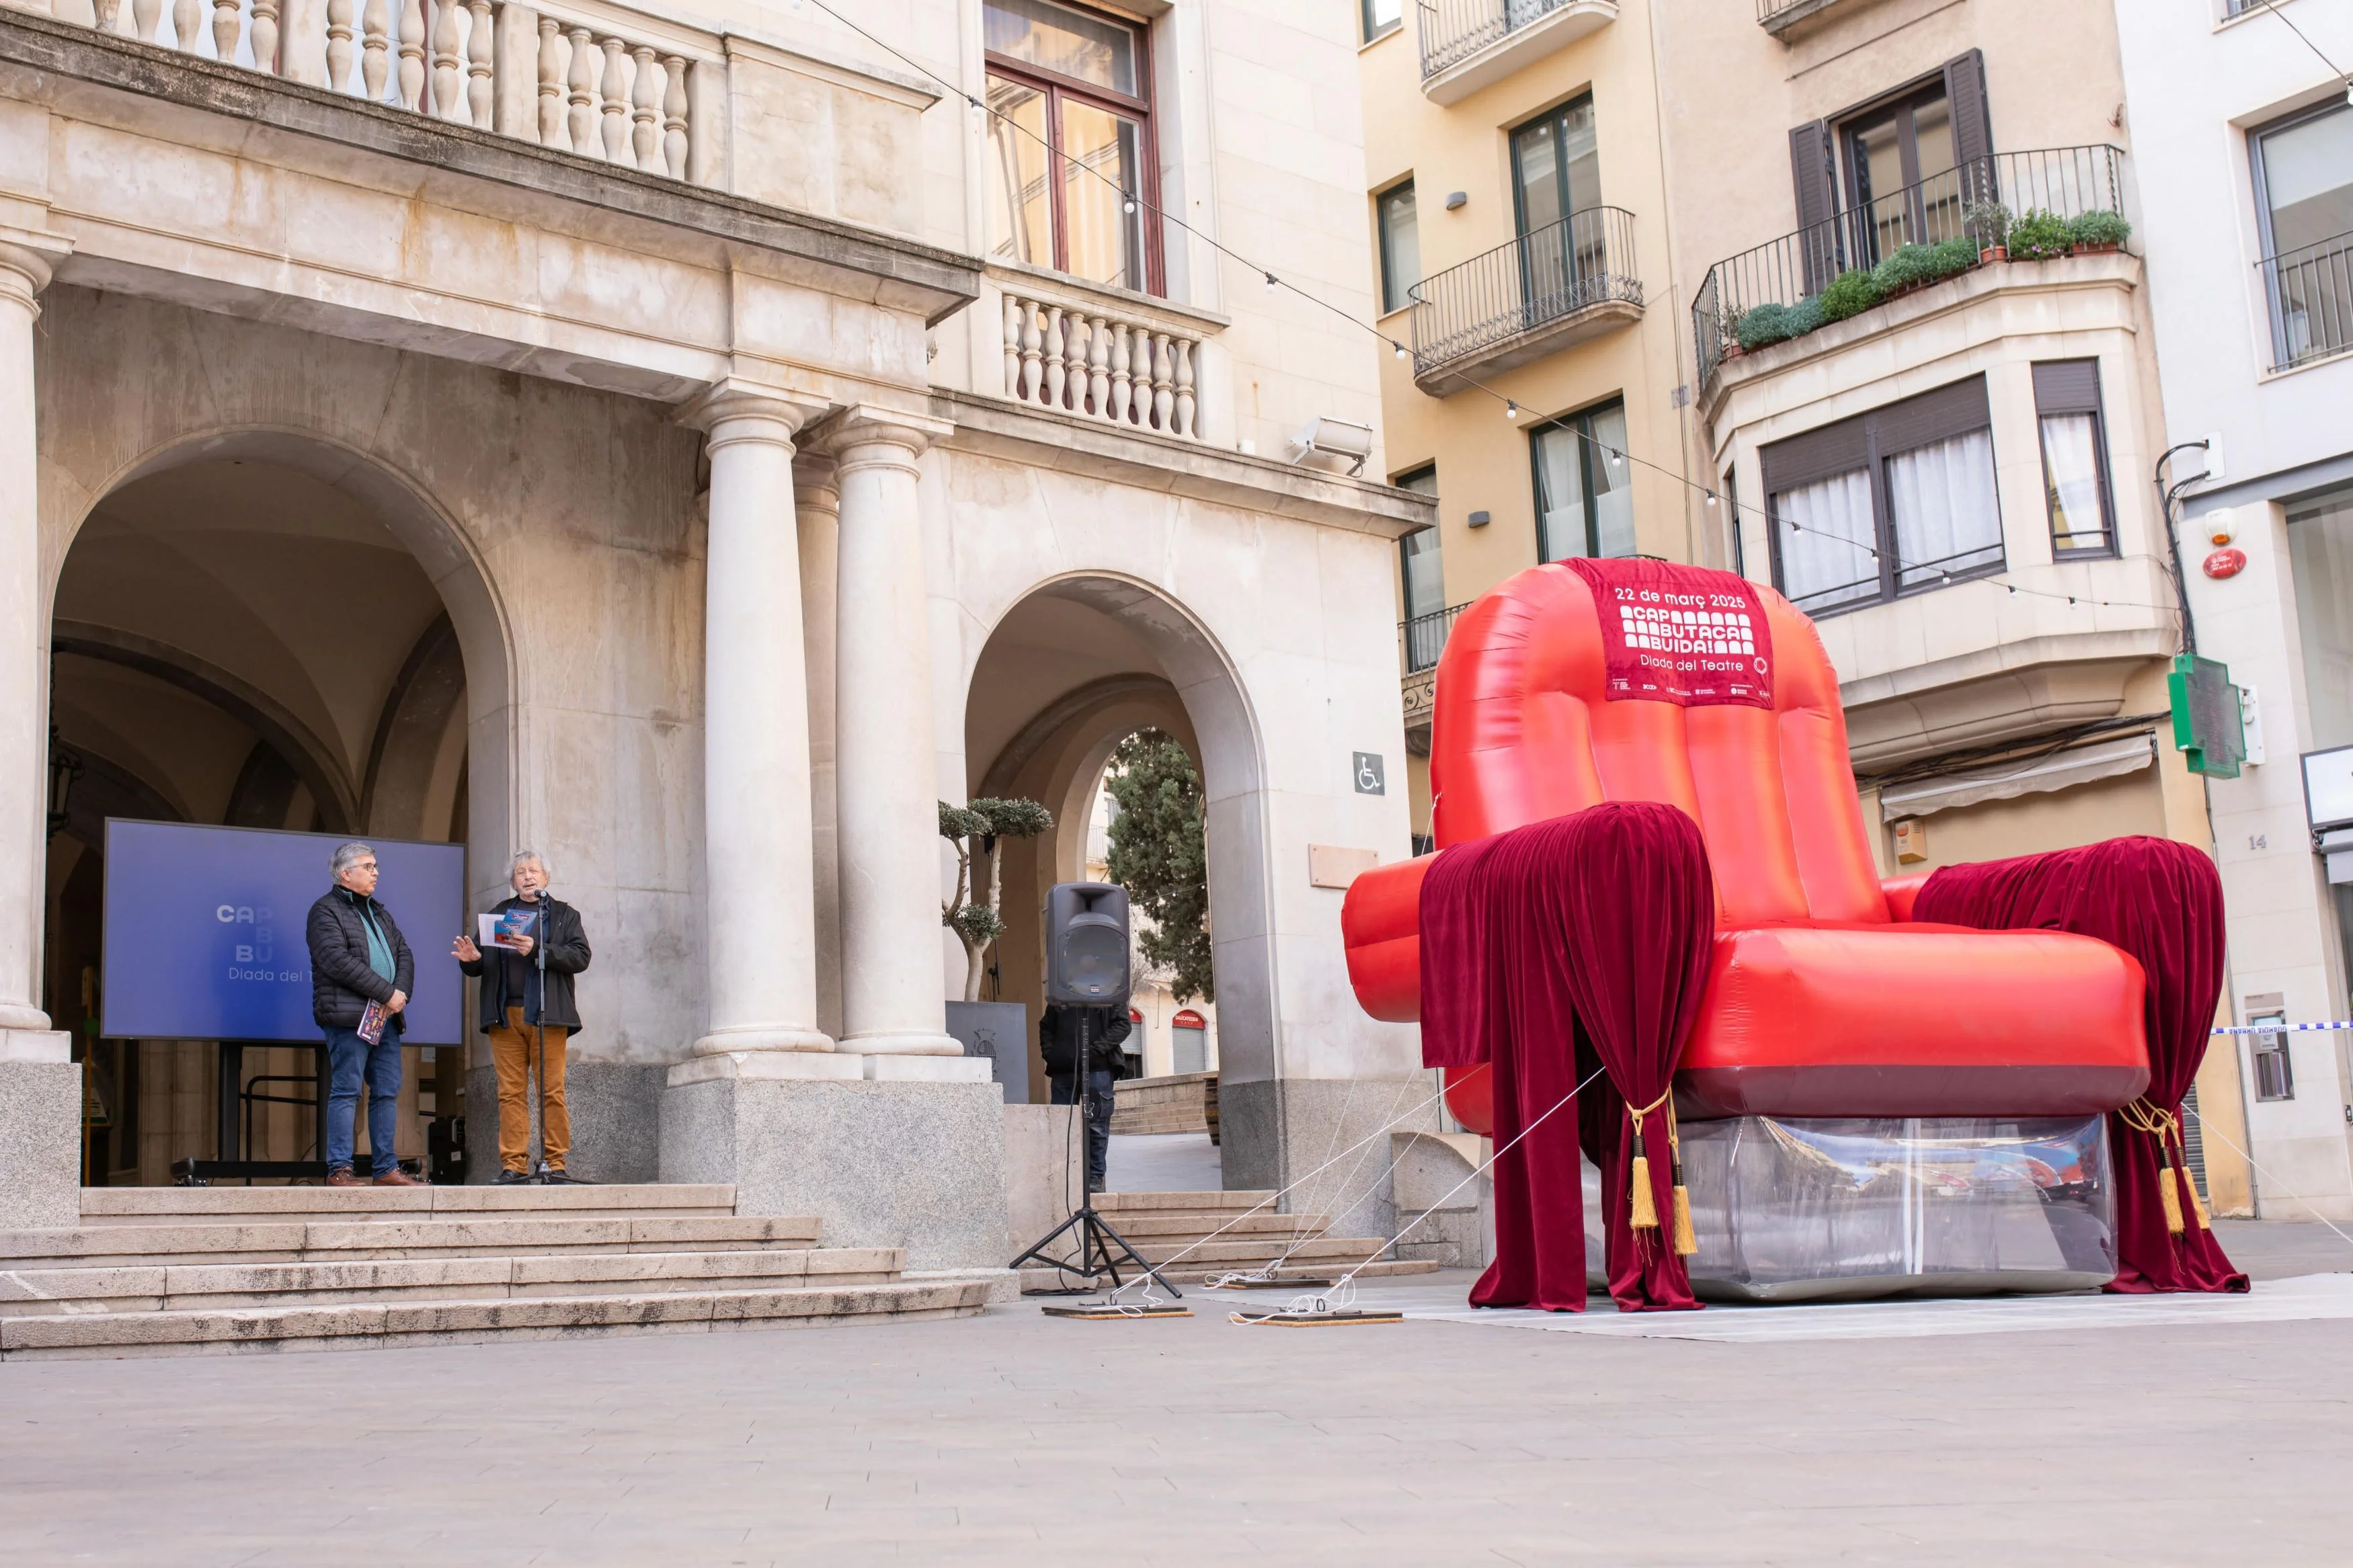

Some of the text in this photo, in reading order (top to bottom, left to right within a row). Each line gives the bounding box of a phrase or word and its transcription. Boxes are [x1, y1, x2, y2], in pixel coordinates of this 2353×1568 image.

[1615, 587, 1746, 610] 22 de març 2025
[1632, 606, 1670, 622] CAP
[1660, 623, 1741, 640] BUTACA
[1650, 635, 1714, 654] BUIDA!
[1640, 654, 1743, 671] Diada del Teatre
[2247, 834, 2267, 850] 14
[229, 966, 274, 981] Diada
[280, 970, 303, 982] del
